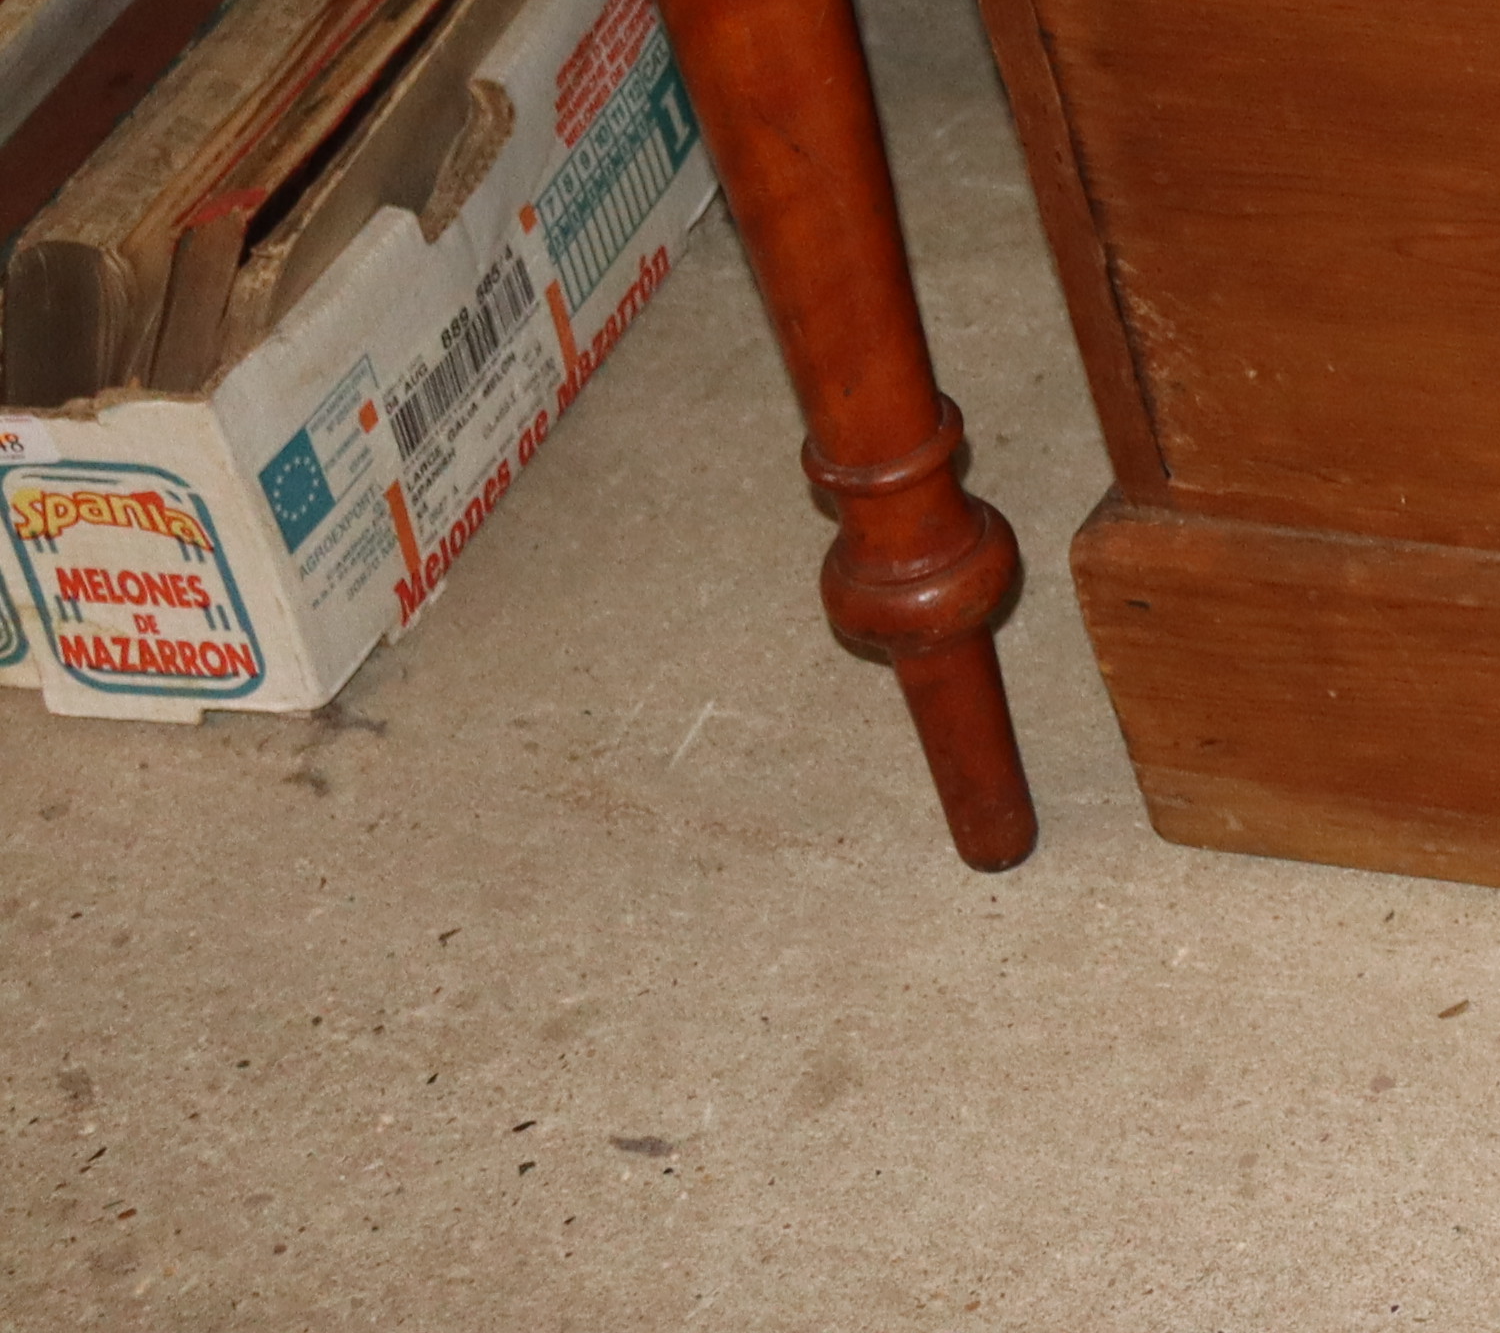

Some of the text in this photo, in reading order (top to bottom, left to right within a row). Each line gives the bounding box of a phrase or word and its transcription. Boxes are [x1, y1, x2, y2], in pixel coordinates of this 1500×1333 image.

[404, 362, 429, 394] AUG
[393, 458, 512, 628] Melones
[556, 244, 671, 421] Mazarrón
[55, 566, 212, 609] MELONES
[132, 613, 161, 634] DE
[58, 634, 259, 679] MAZARRON
